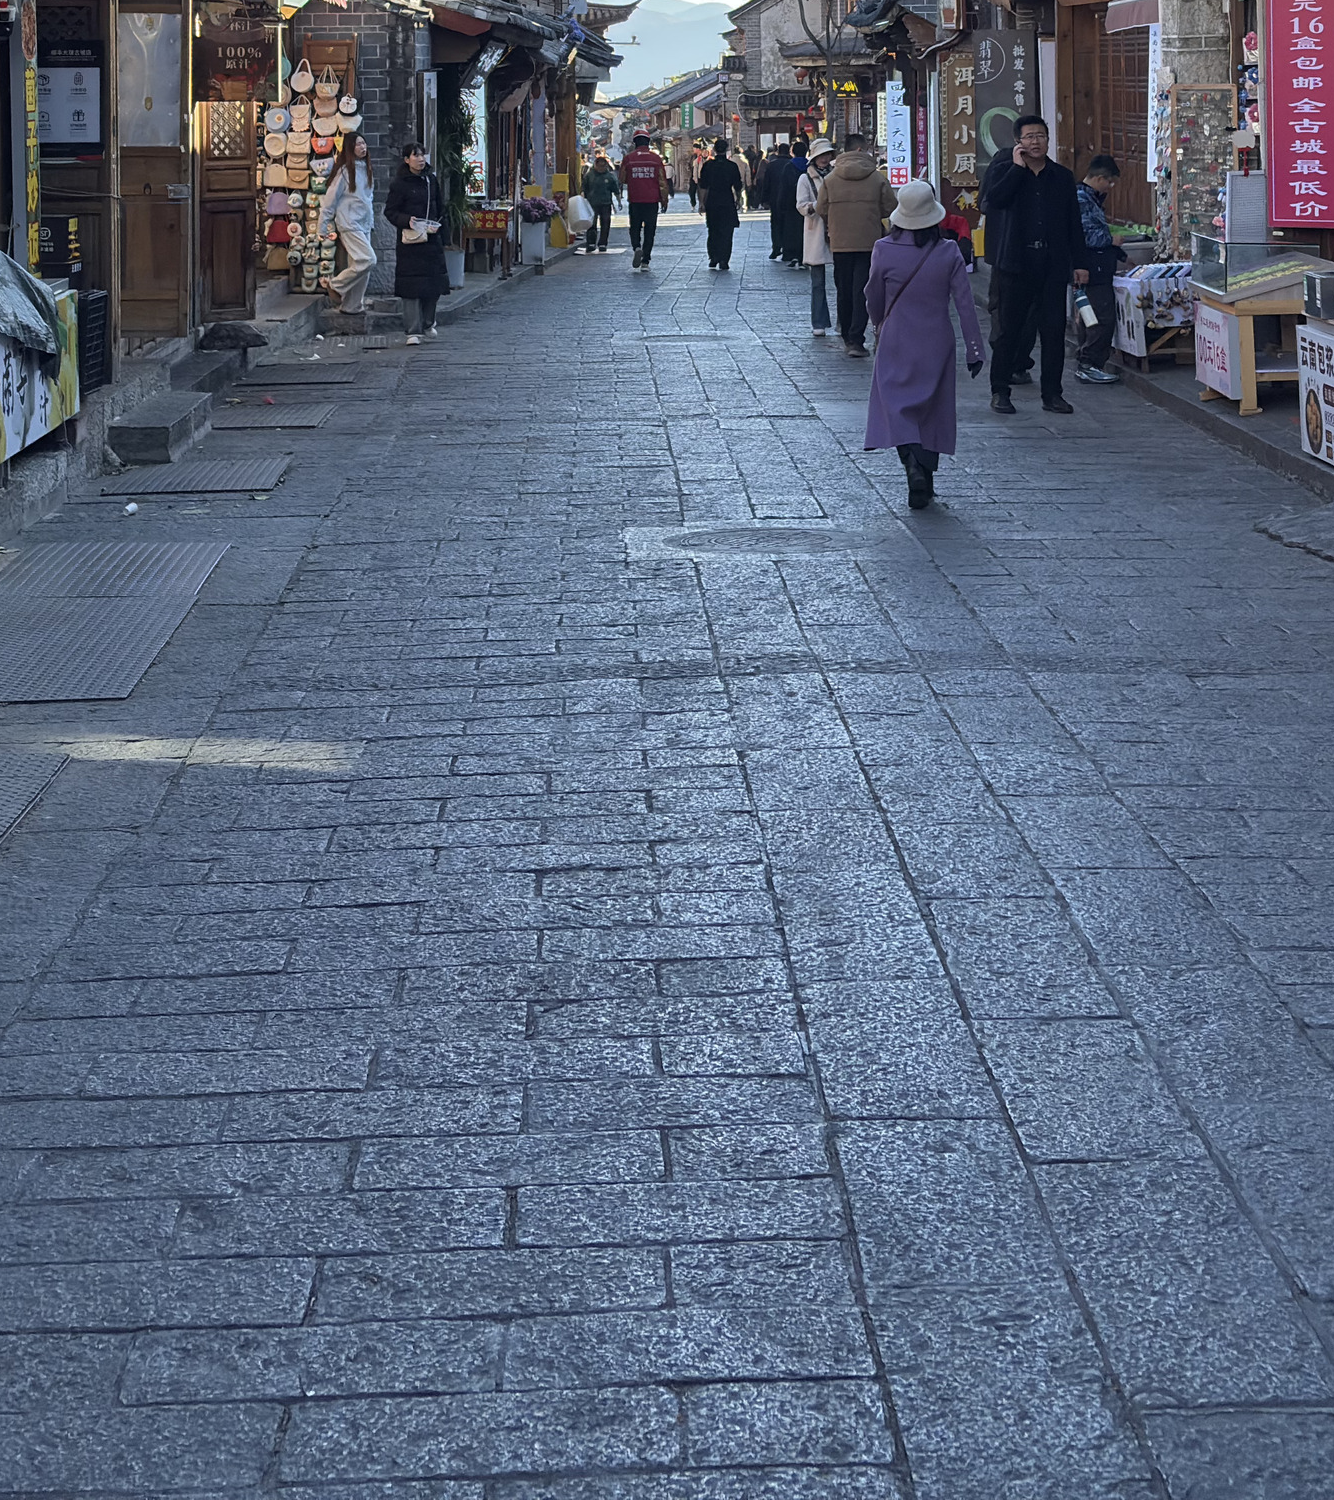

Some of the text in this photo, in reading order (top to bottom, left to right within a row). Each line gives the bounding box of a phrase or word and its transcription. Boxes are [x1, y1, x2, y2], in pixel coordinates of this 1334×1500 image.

[217, 46, 262, 59] 100%
[976, 39, 995, 81] 翡翠
[952, 65, 977, 175] 洱月小厨
